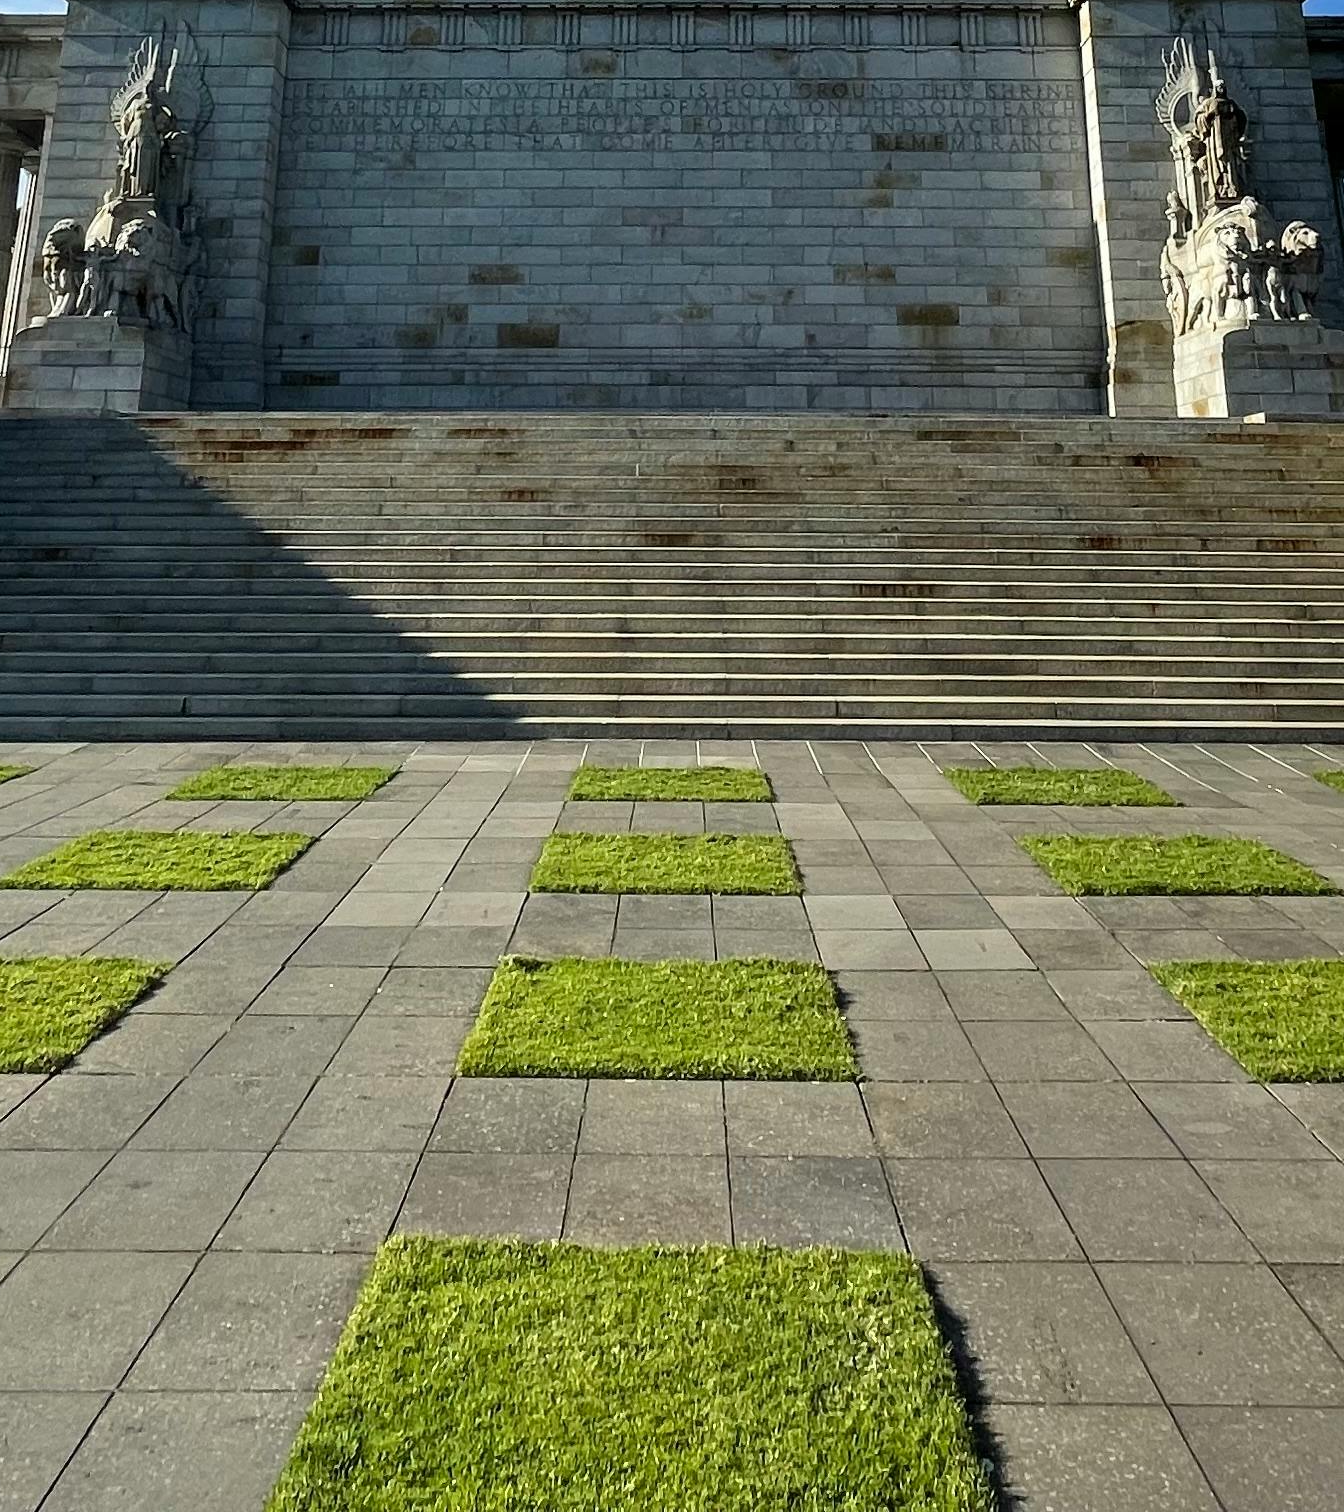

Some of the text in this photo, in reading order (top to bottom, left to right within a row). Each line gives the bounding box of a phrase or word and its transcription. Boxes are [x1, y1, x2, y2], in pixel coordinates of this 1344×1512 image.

[293, 83, 1074, 99] LET ALL MEN KNOW THAT THIS IS HOLY GROUND THIS SHRINE
[293, 100, 1075, 116] ESTABLISHED IN THE HEARTS OF MEN AS ON THE SOLID EARTH
[290, 118, 507, 133] COMMEMORATES
[527, 118, 539, 133] A
[864, 118, 915, 133] AND
[288, 135, 315, 151] YE
[334, 135, 493, 151] THEREFORE
[514, 135, 578, 151] THAT
[602, 135, 672, 151] COME
[795, 135, 854, 151] GIVE
[878, 135, 1081, 152] REMEMBRANCE
